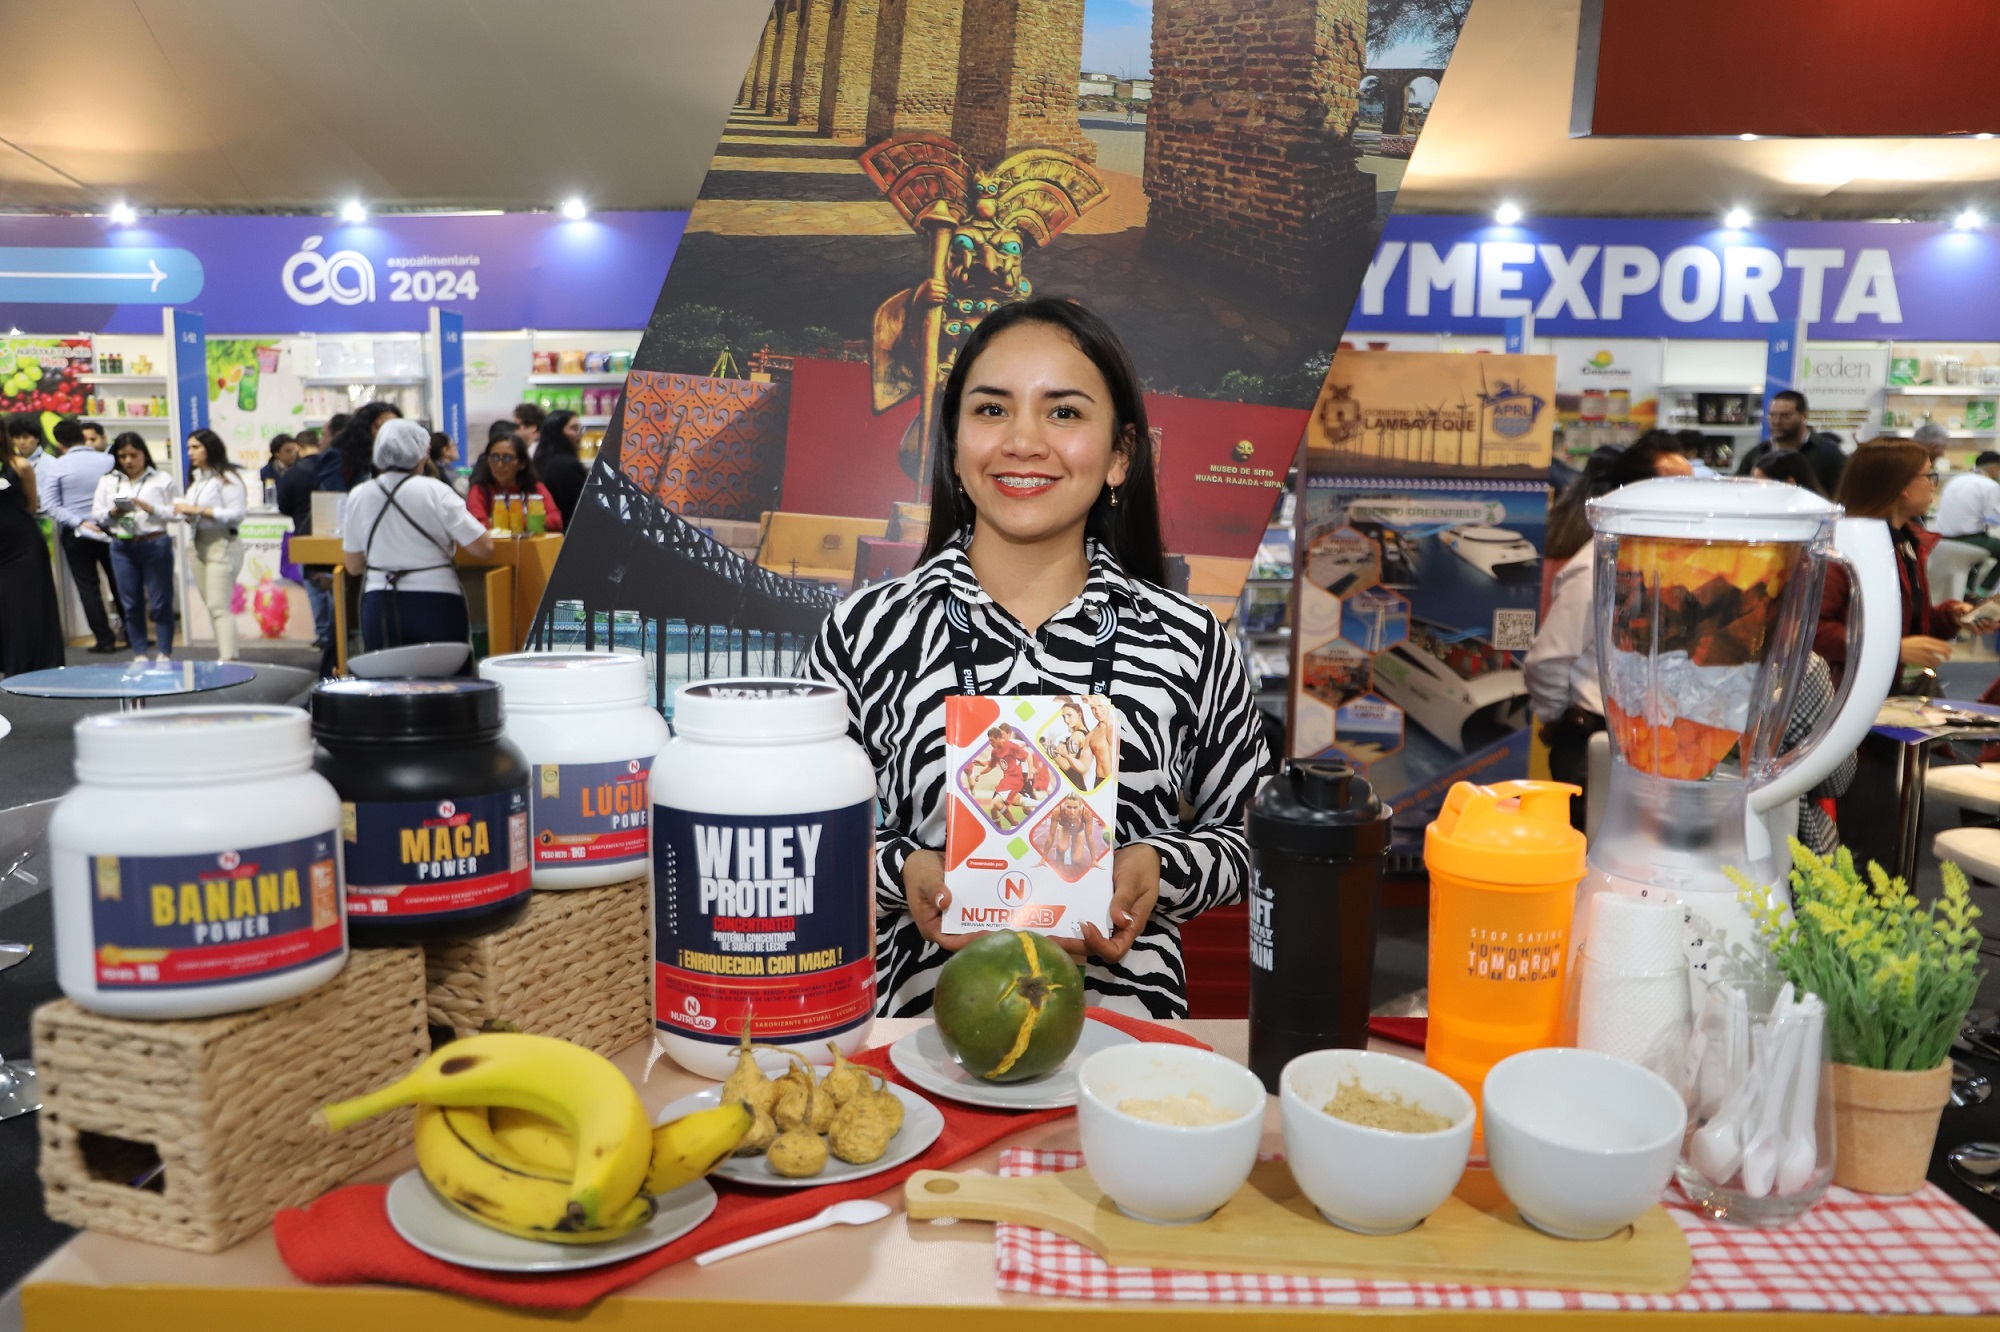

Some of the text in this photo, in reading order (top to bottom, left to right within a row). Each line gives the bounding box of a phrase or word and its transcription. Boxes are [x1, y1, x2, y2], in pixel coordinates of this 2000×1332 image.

[386, 254, 481, 269] expoalimentaria
[388, 270, 480, 302] 2024
[1360, 242, 1903, 324] YMEXPORTA
[1815, 355, 1871, 378] eden
[1364, 409, 1414, 417] GOBIERNO
[1416, 409, 1460, 418] REONAL
[1494, 404, 1532, 417] APRL
[1365, 418, 1476, 432] LAMBAYEQUE
[1194, 474, 1223, 483] HUACA
[1210, 464, 1274, 477] MUSEO DE SITIO
[1407, 507, 1482, 519] GREENFIELD
[963, 669, 976, 696] alma
[582, 782, 649, 818] LÚCU
[612, 811, 648, 830] POWE
[400, 821, 490, 864] MACA
[693, 824, 823, 879] WHEY
[570, 846, 586, 859] 1KG
[419, 857, 478, 880] POWER
[151, 869, 301, 927] BANANA
[700, 876, 814, 918] PROTEIN
[1004, 877, 1025, 901] N
[713, 917, 796, 932] CONCENTRATED
[961, 907, 1055, 926] NUTRIAB
[1684, 914, 1691, 923] 2
[195, 914, 270, 944] POWER
[745, 931, 796, 943] CONCENTRADA
[1250, 918, 1274, 940] WAY
[1471, 928, 1563, 943] STOP SAYING
[722, 942, 788, 952] DE SUERO DE LECHE
[1696, 938, 1703, 947] 3
[1250, 936, 1274, 972] AIN
[768, 955, 796, 975] CON
[1469, 950, 1561, 980] TOMORROW
[1700, 963, 1708, 971] 4
[687, 999, 697, 1013] N
[671, 1010, 711, 1028] NUTRILAB
[755, 1019, 801, 1028] SABORIZANTE
[803, 1014, 832, 1024] NATURAL
